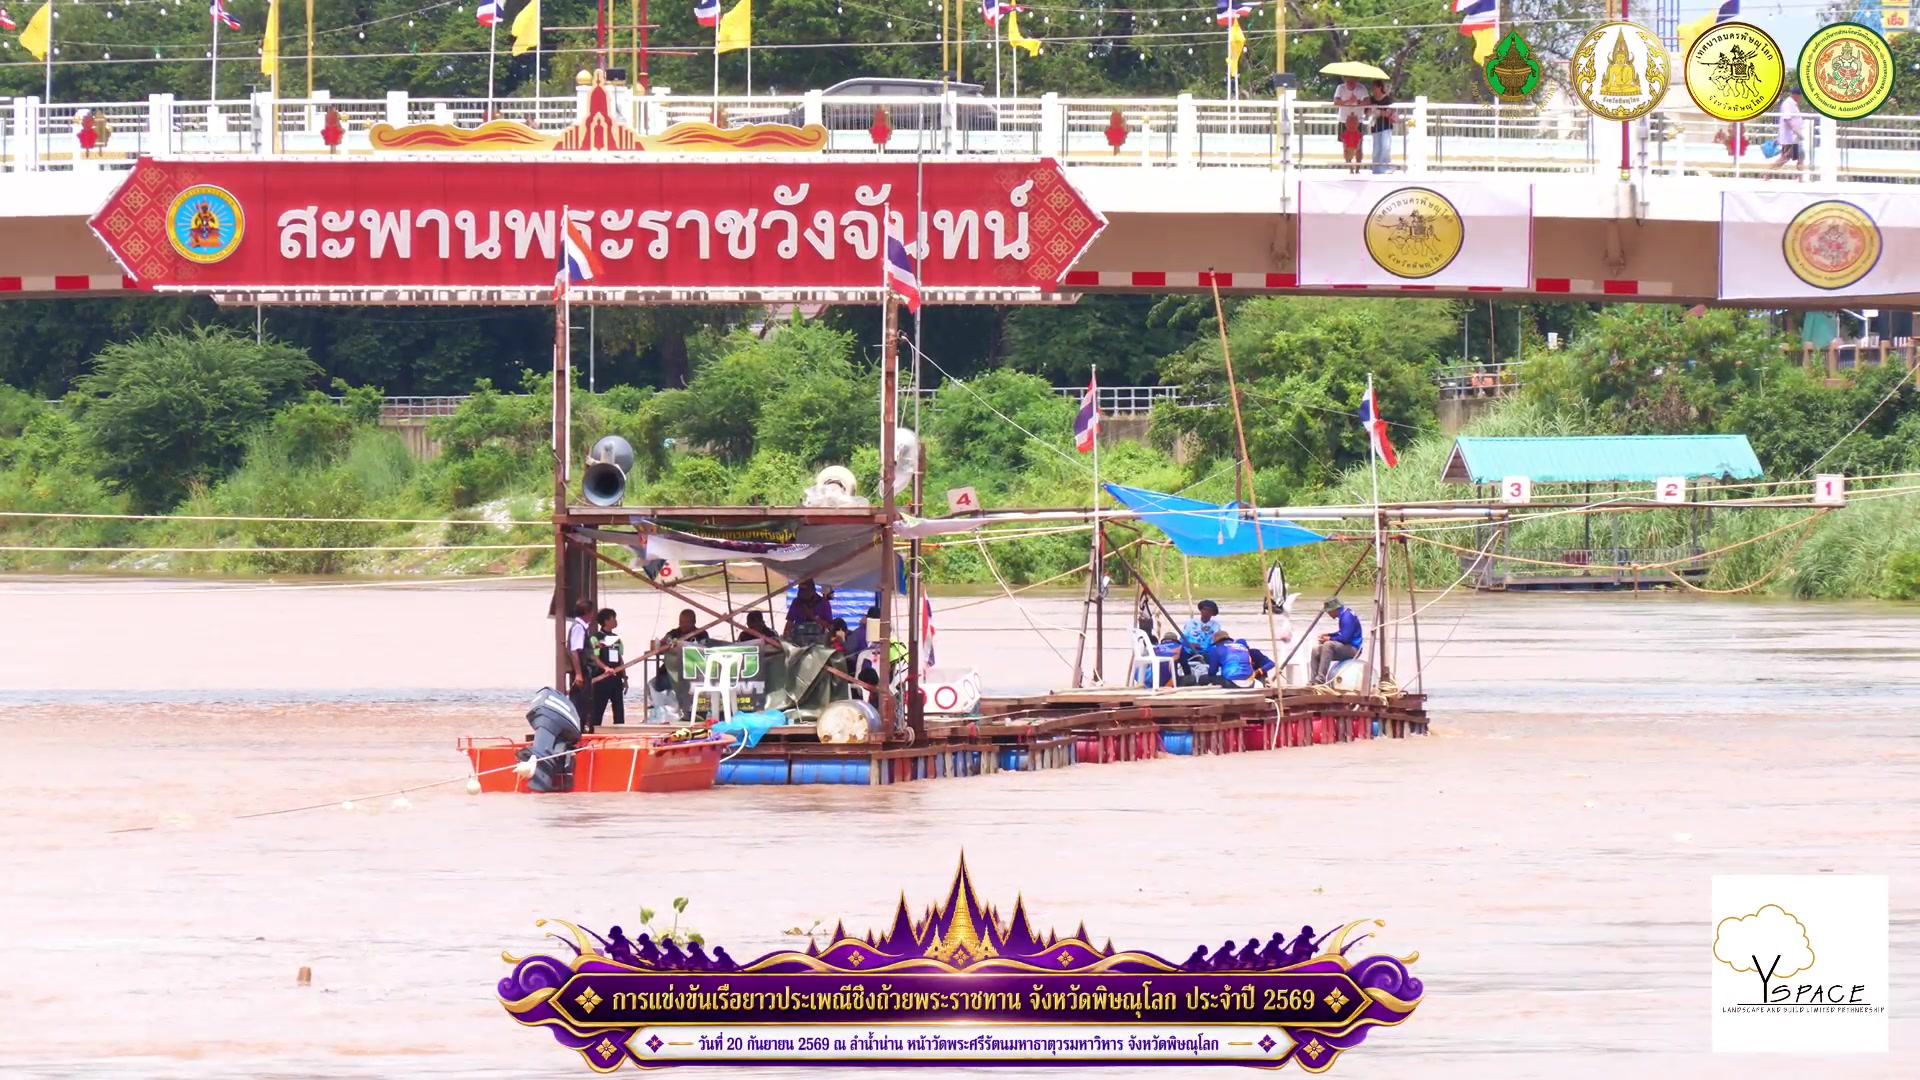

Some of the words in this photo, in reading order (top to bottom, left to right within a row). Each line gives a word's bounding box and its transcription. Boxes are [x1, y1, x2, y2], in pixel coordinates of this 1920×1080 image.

[277, 179, 1034, 262] สะพานพระราชวังจันทน์
[1510, 483, 1522, 498] 3
[1664, 483, 1678, 497] 2
[1824, 481, 1832, 497] 1
[955, 492, 973, 507] 4
